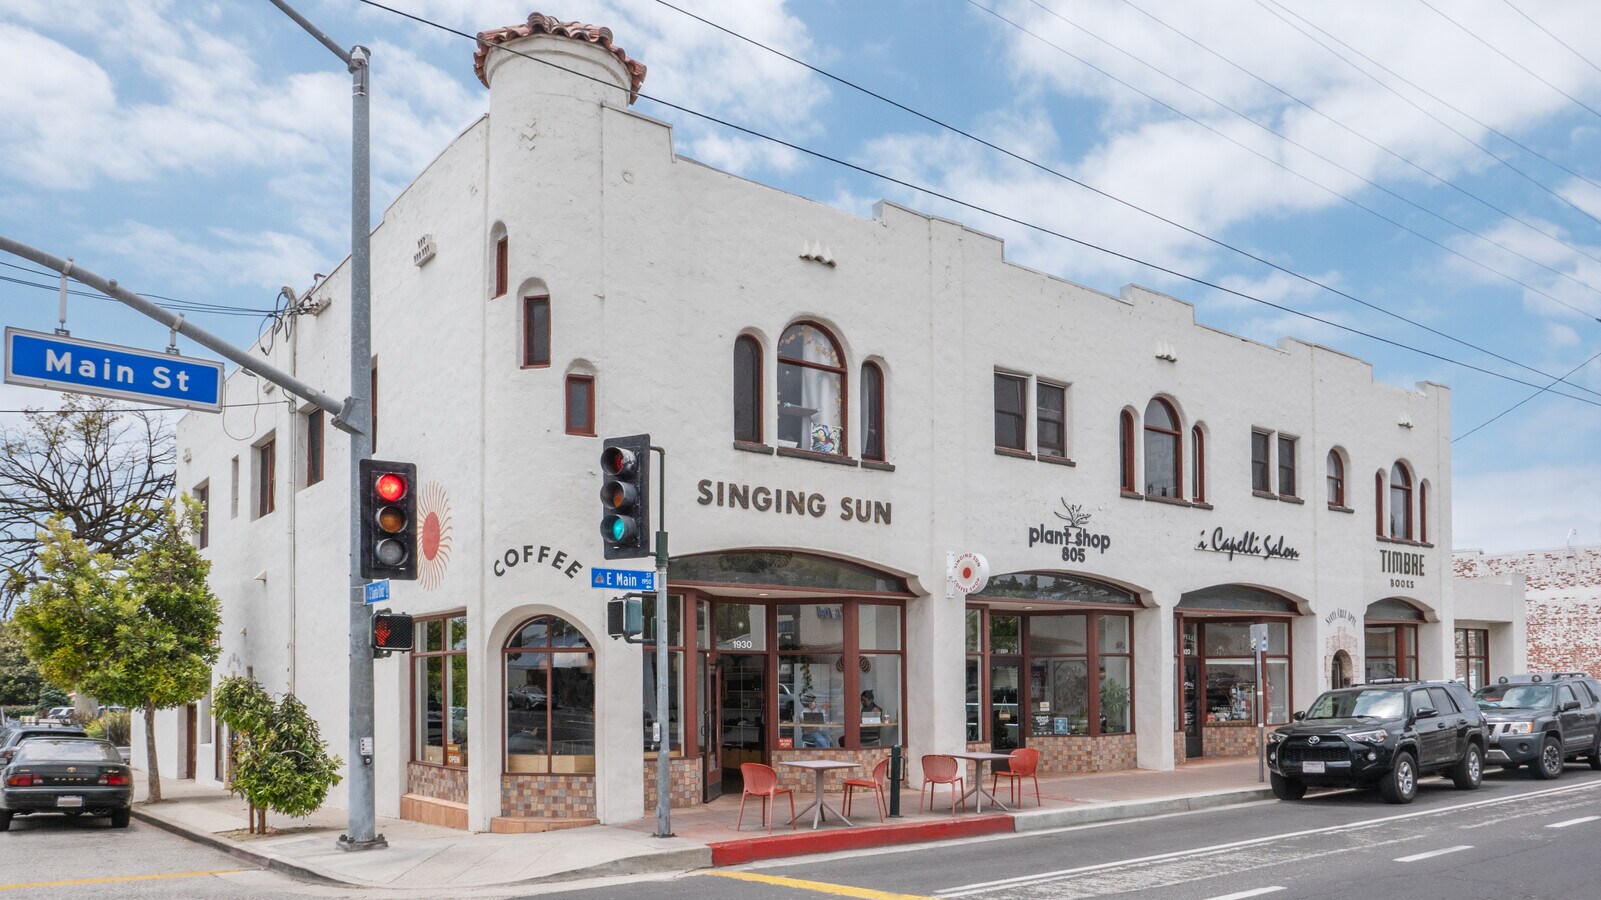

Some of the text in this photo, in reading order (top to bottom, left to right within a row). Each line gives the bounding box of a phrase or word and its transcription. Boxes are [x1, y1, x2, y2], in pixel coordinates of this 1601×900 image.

[46, 348, 190, 392] Main St
[696, 479, 892, 525] SINGING SUN
[1028, 523, 1111, 554] plant shop
[1198, 526, 1300, 561] i Capelli Salon
[493, 545, 583, 580] COFFEE
[953, 552, 972, 569] SINGING
[1061, 546, 1086, 563] 805
[1379, 549, 1425, 577] TIMBRE
[606, 572, 637, 587] E Main
[953, 577, 981, 593] COFFEE SHOP
[1390, 578, 1415, 589] BOOKS
[732, 640, 753, 649] 1930
[448, 755, 460, 764] OPEN
